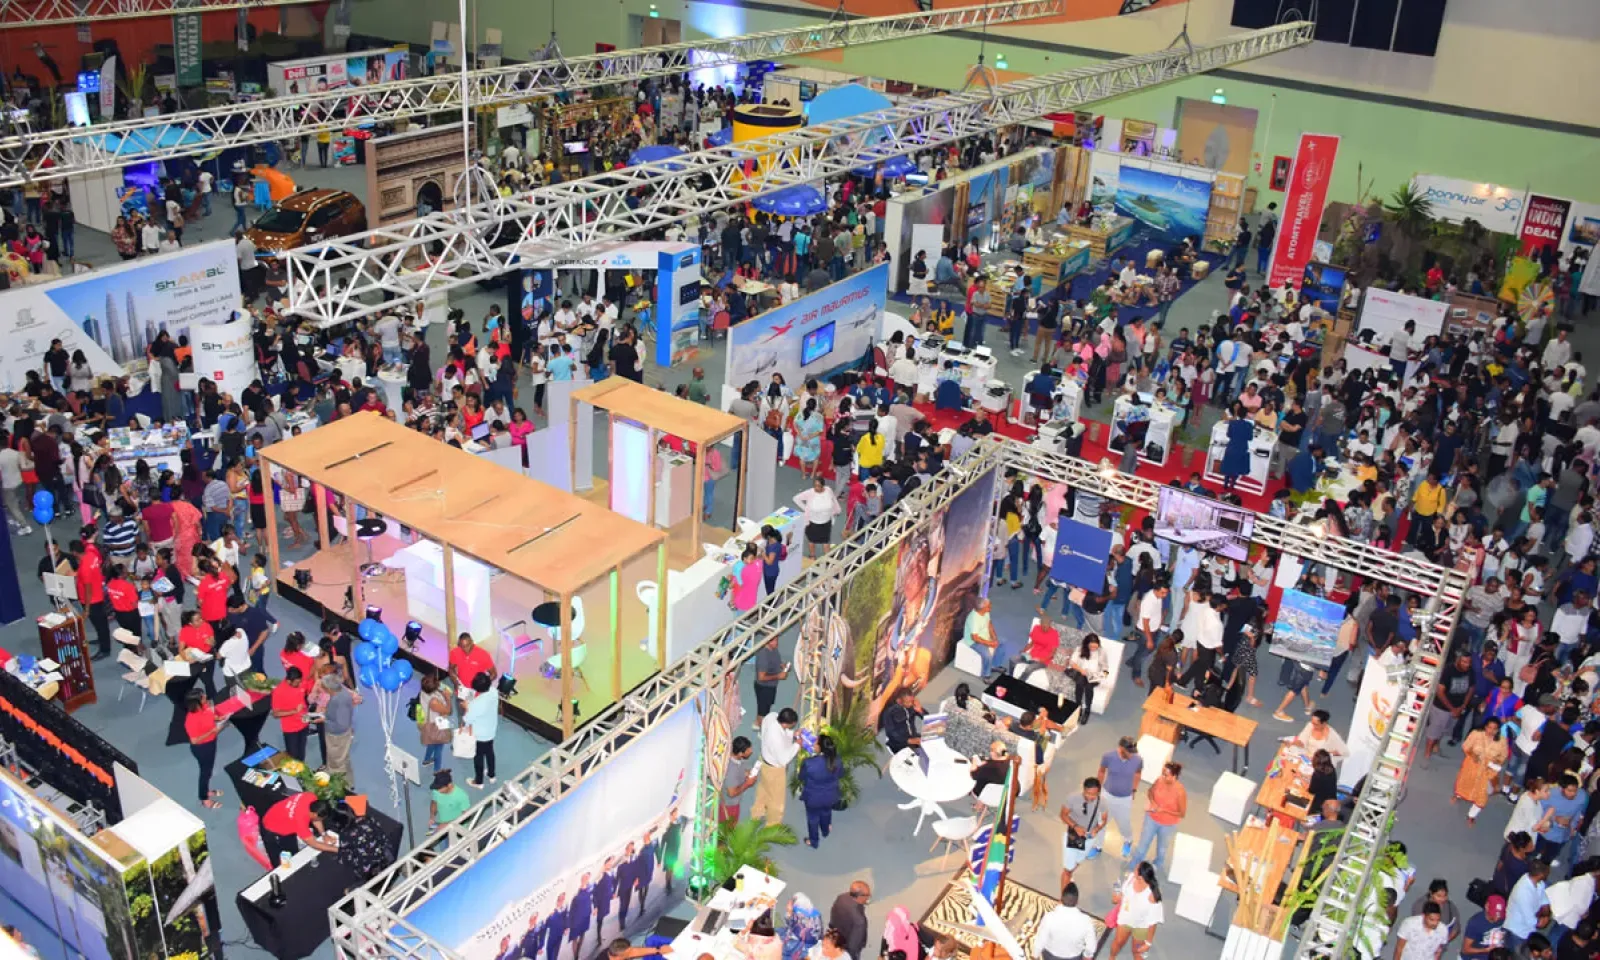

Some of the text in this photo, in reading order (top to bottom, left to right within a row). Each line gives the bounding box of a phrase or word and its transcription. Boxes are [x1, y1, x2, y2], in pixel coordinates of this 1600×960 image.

[188, 15, 199, 67] WORLD
[1287, 193, 1306, 259] ATOMTRAVEL
[1524, 225, 1558, 240] DEAL
[1528, 208, 1562, 228] INDIA
